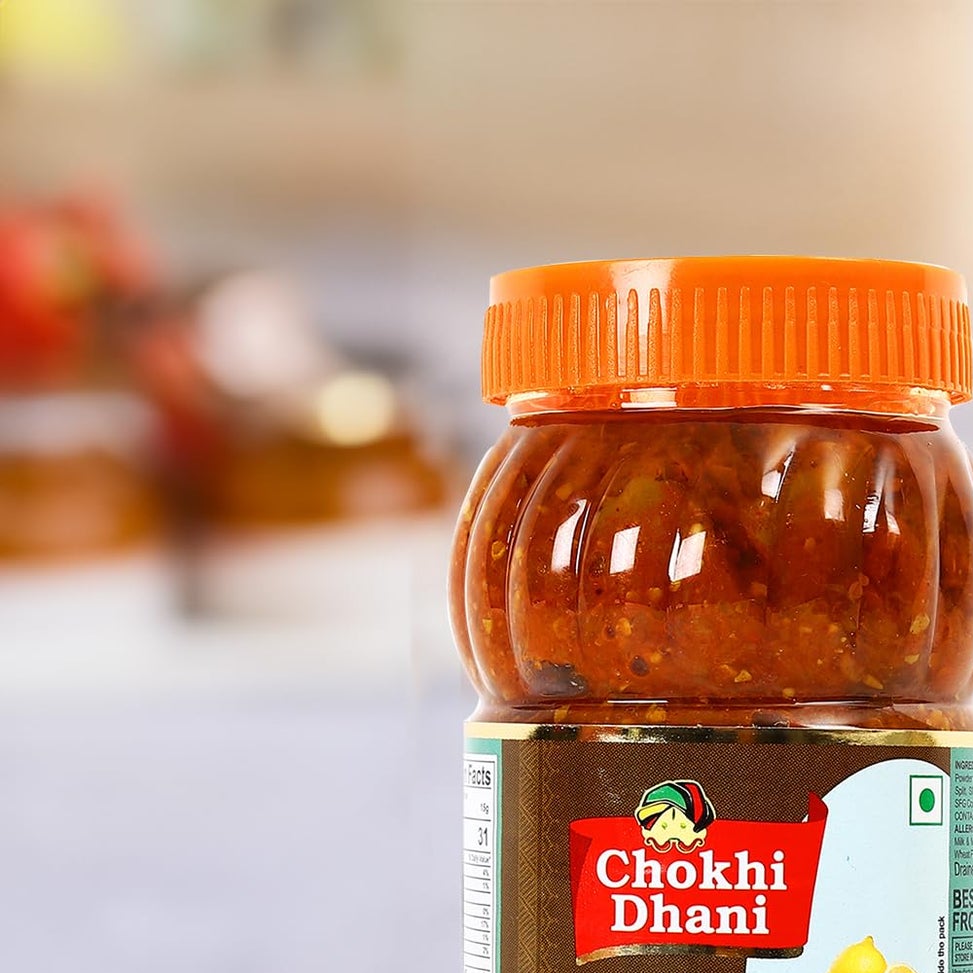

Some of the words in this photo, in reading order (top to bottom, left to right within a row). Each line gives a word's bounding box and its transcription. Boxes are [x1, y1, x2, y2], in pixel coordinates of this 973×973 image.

[478, 827, 488, 846] 31
[596, 848, 788, 890] Chokhi
[610, 893, 770, 934] Dhani
[938, 916, 946, 940] pack
